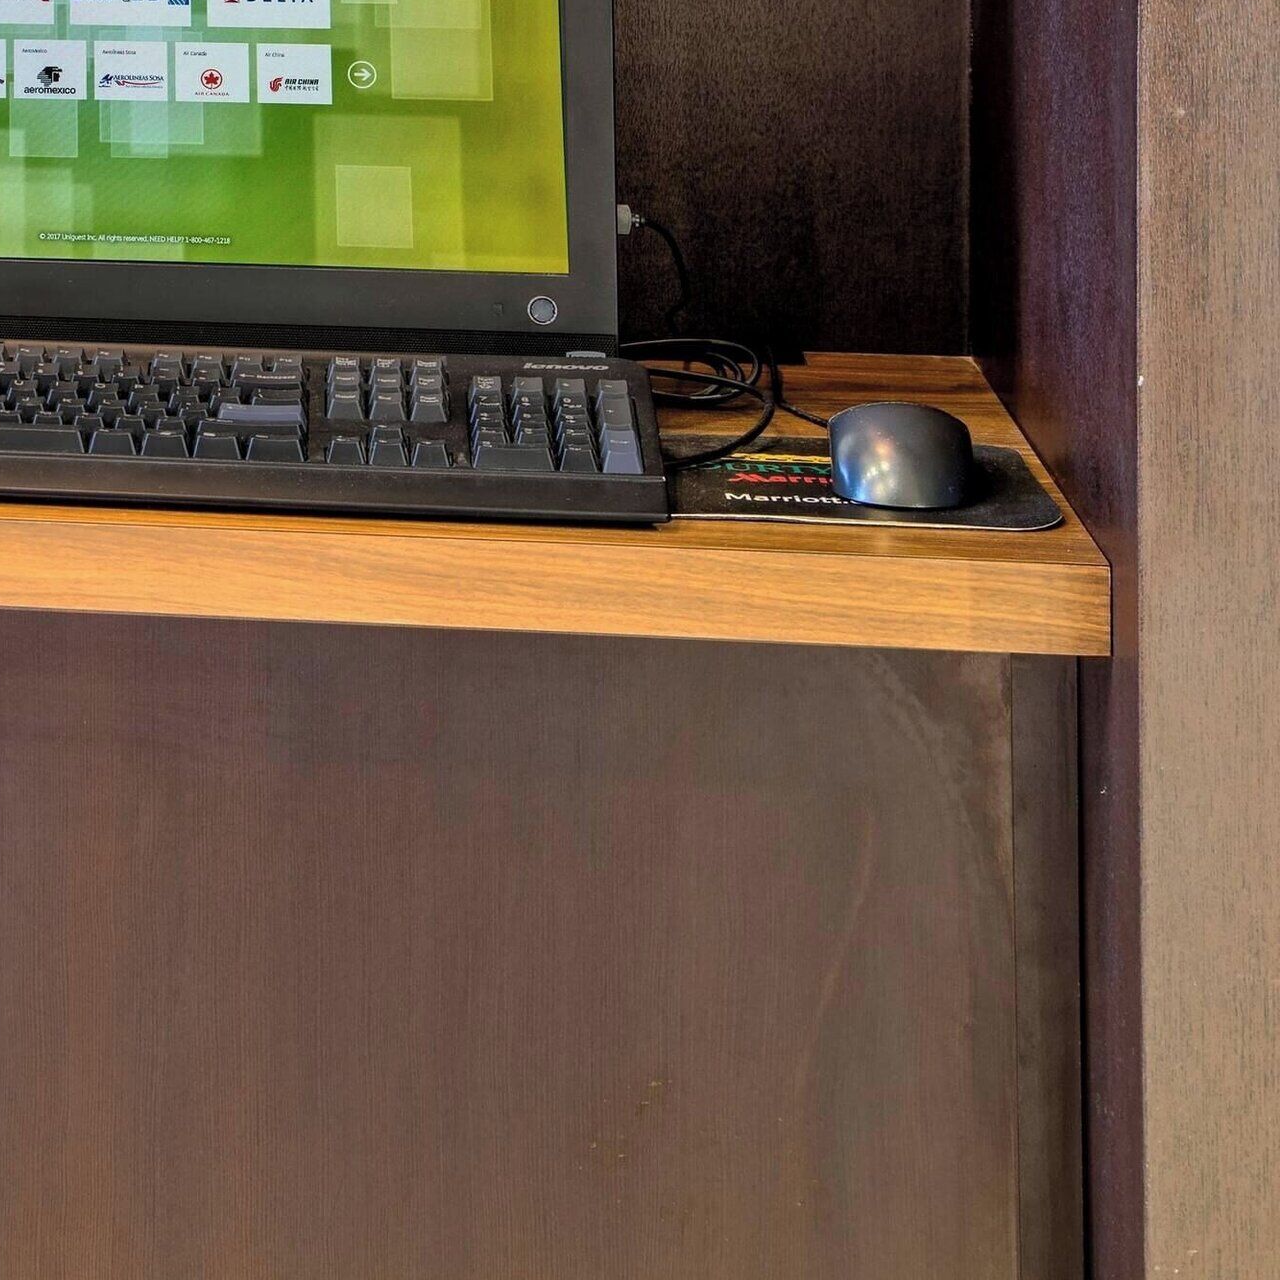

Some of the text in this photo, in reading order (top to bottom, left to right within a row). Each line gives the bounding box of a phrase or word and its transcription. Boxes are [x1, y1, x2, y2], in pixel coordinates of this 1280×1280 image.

[23, 86, 77, 95] aeromexico
[106, 234, 122, 243] rights
[523, 362, 610, 371] lenovo
